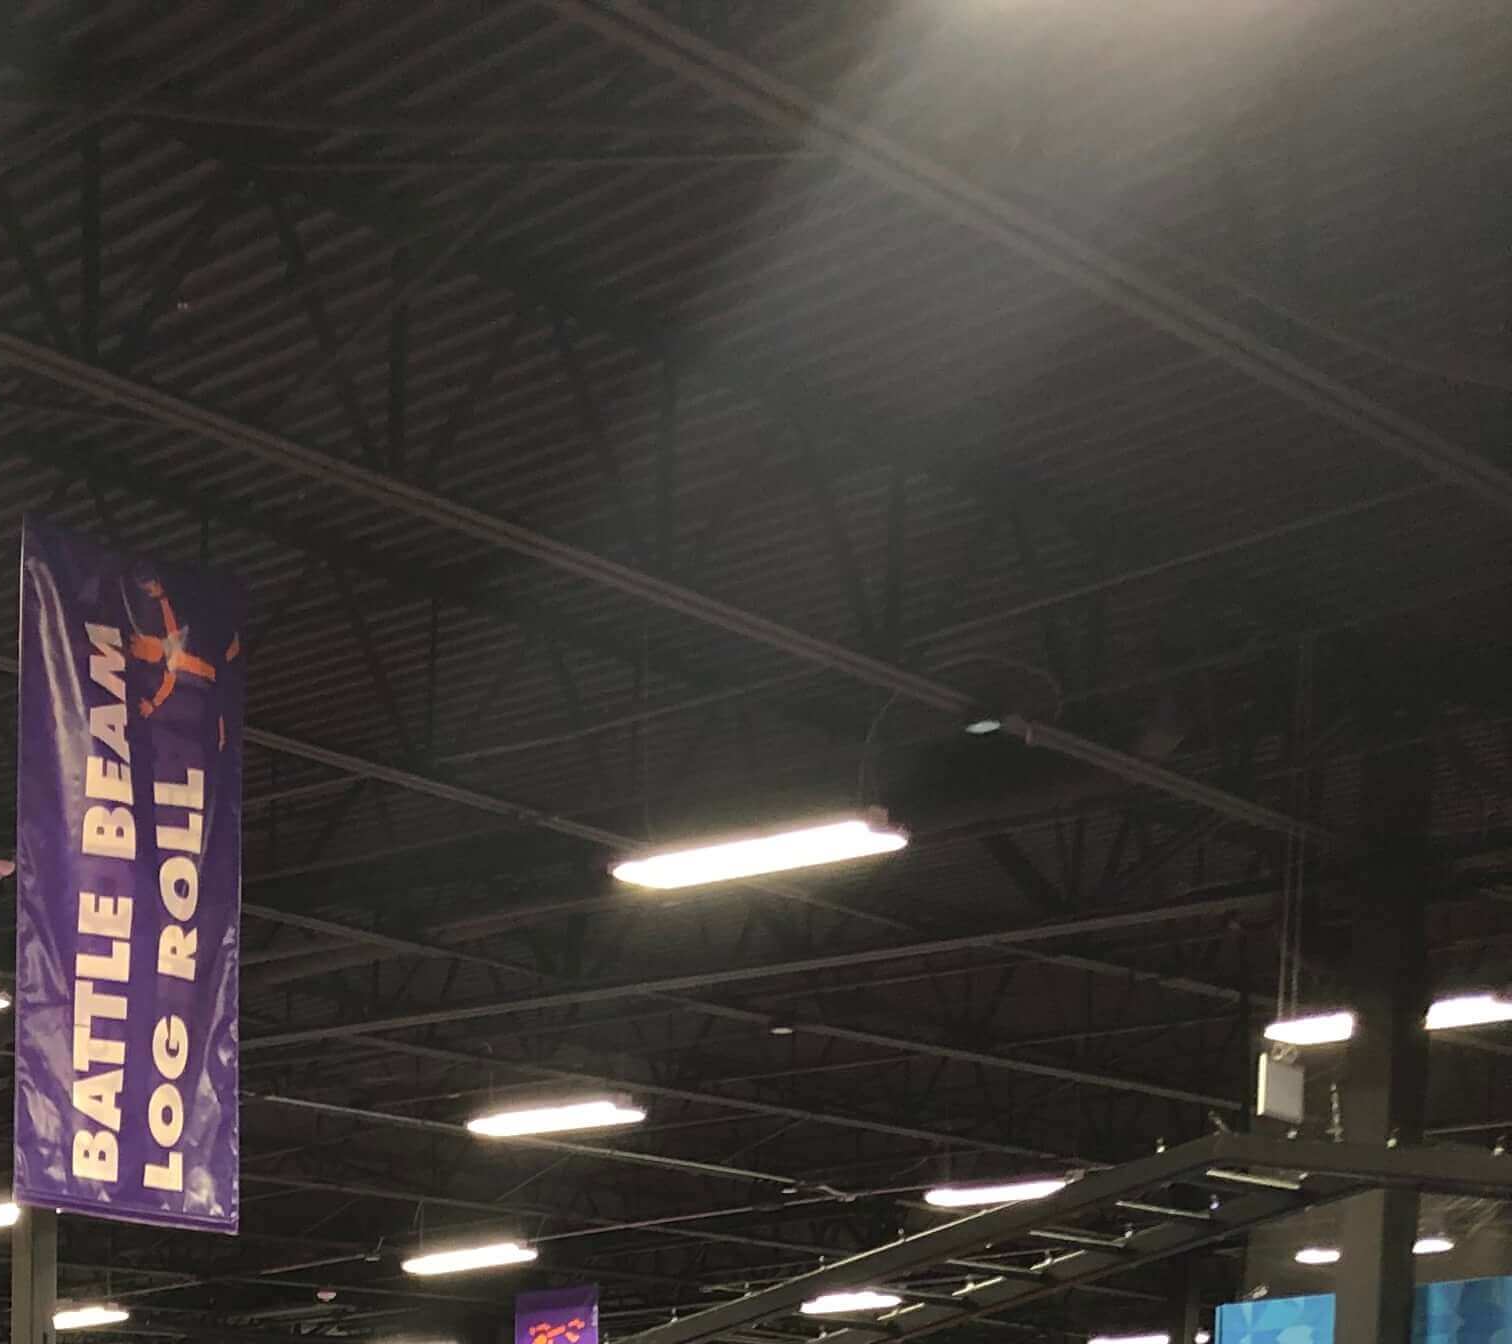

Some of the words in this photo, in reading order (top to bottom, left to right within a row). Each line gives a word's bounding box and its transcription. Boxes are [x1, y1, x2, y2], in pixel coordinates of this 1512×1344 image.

[83, 622, 136, 861] BEAM
[154, 768, 204, 982] ROLL
[73, 893, 133, 1182] BATTLE
[144, 1014, 190, 1193] LOG
